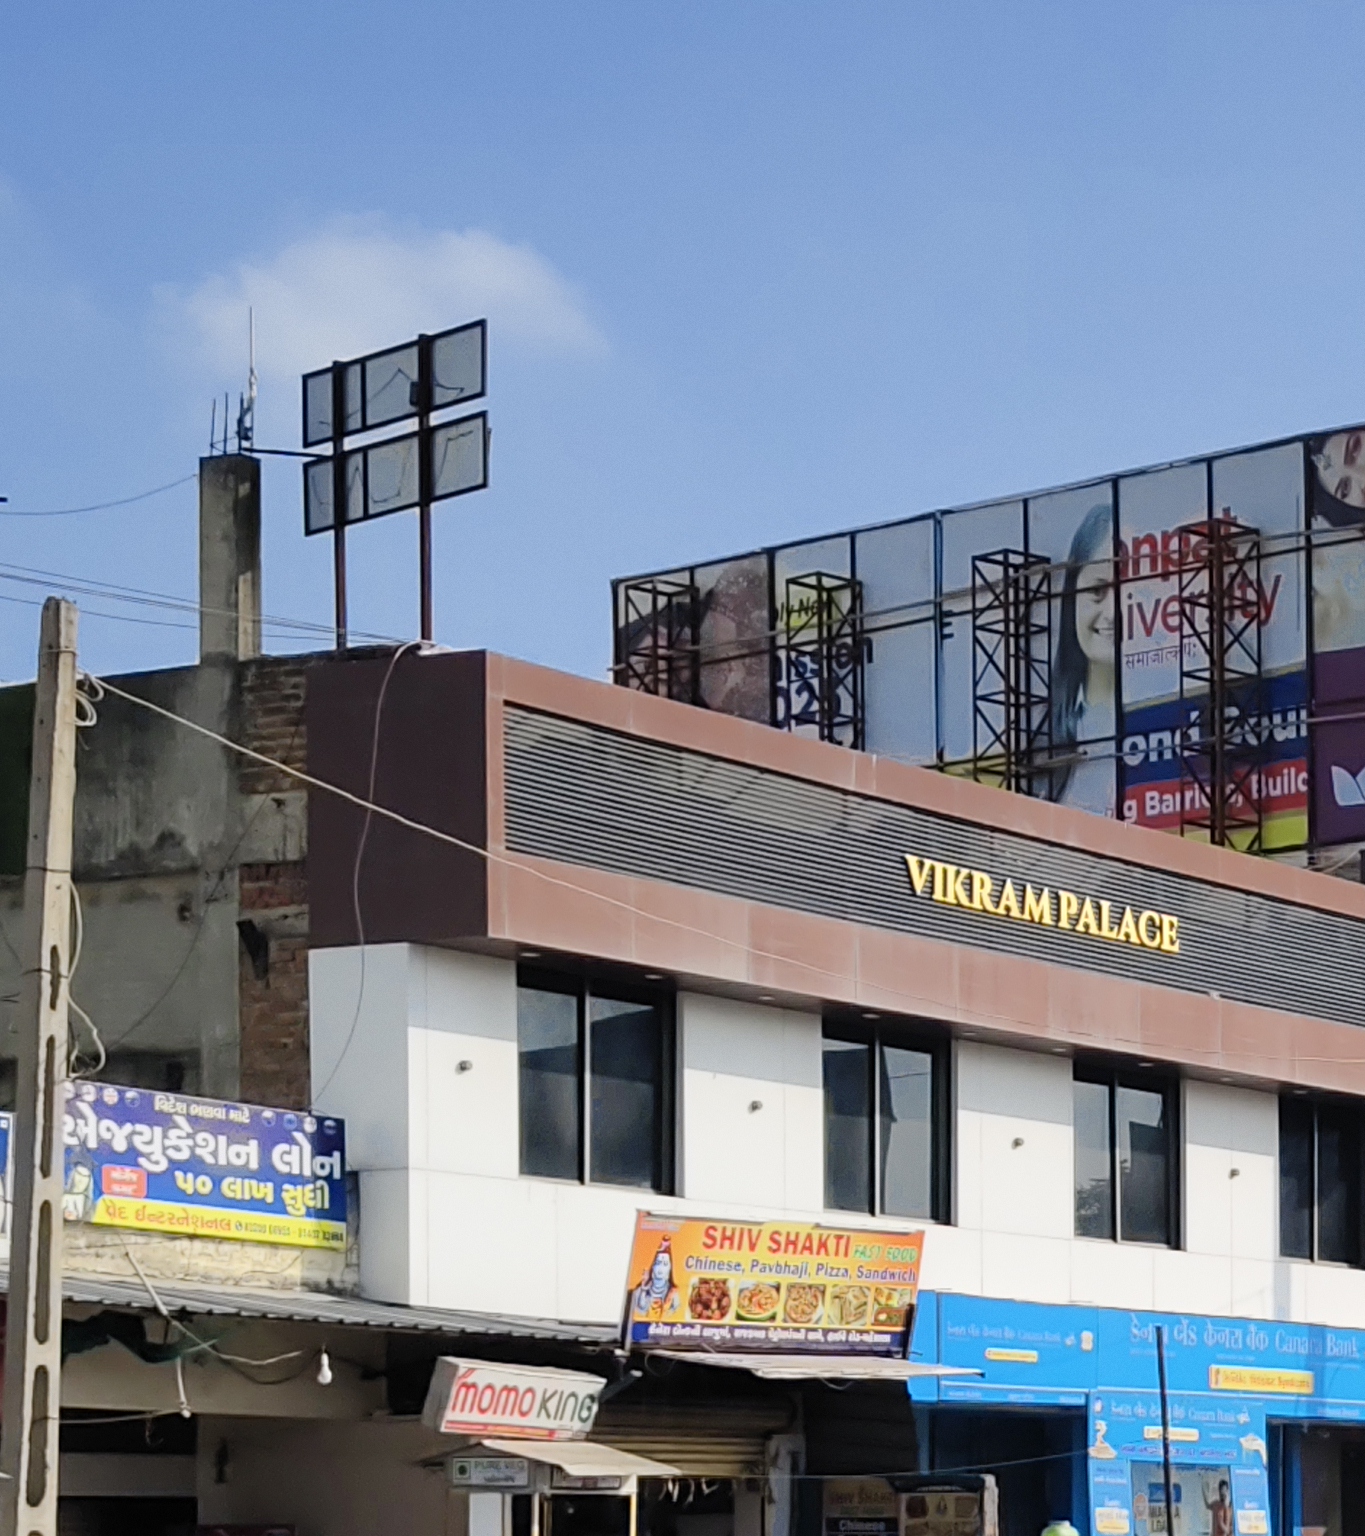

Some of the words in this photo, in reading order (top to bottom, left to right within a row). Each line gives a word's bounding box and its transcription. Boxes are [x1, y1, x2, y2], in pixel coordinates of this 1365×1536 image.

[905, 854, 1052, 926] VIKRAM
[1057, 890, 1181, 954] PALACE
[272, 1130, 342, 1181] લોન
[702, 1224, 763, 1254] SHIV
[766, 1229, 851, 1258] SHAKTI
[685, 1254, 745, 1275] Chinese,
[815, 1262, 851, 1281] Pizza,
[856, 1264, 917, 1283] Sandwich
[1275, 1328, 1324, 1356] Canara
[1326, 1333, 1359, 1360] Bank
